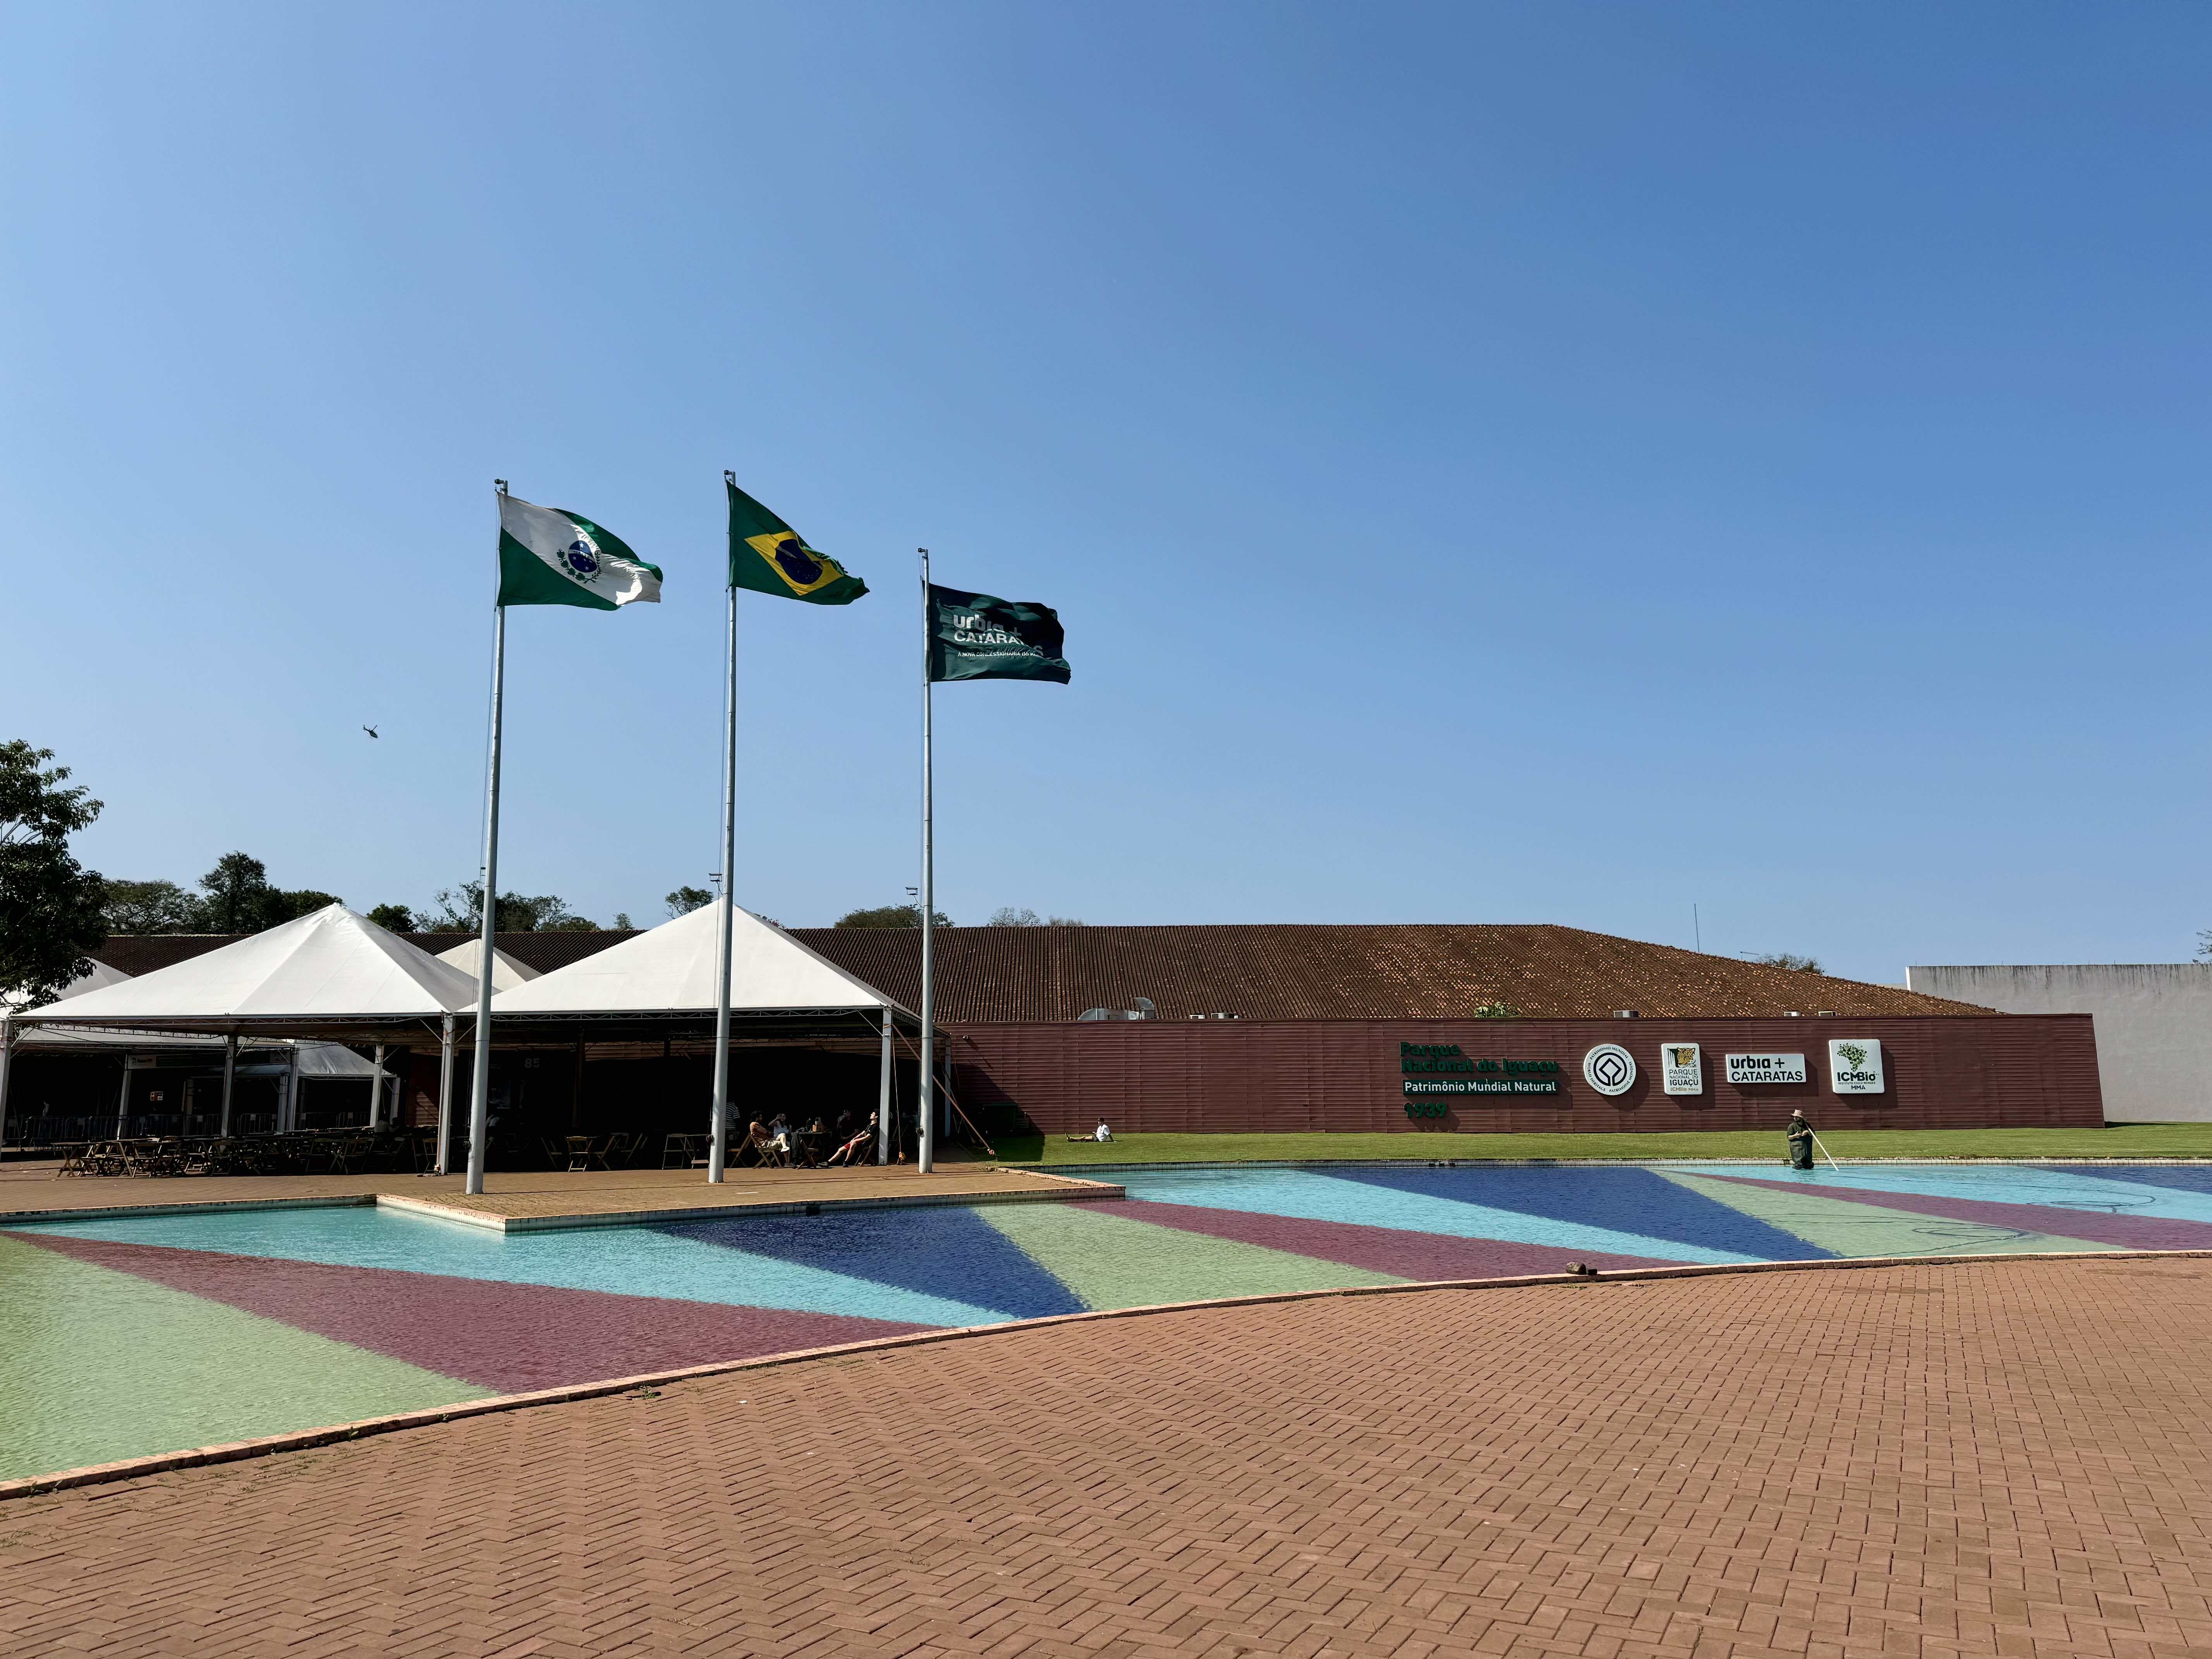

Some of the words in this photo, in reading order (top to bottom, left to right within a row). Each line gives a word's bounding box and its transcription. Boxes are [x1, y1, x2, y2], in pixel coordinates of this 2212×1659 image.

[1400, 1042, 1460, 1059] Parque
[1401, 1058, 1473, 1072] Nacional
[1477, 1059, 1498, 1072] do
[1501, 1058, 1558, 1076] Iguaçu
[1730, 1055, 1771, 1069] urbia
[1731, 1070, 1803, 1082] CATARATAS
[1837, 1072, 1875, 1081] ICMBio
[1405, 1081, 1465, 1092] Patrimônio
[1468, 1081, 1511, 1092] Mundial
[1515, 1081, 1556, 1092] Natural
[1404, 1103, 1448, 1118] 1939
